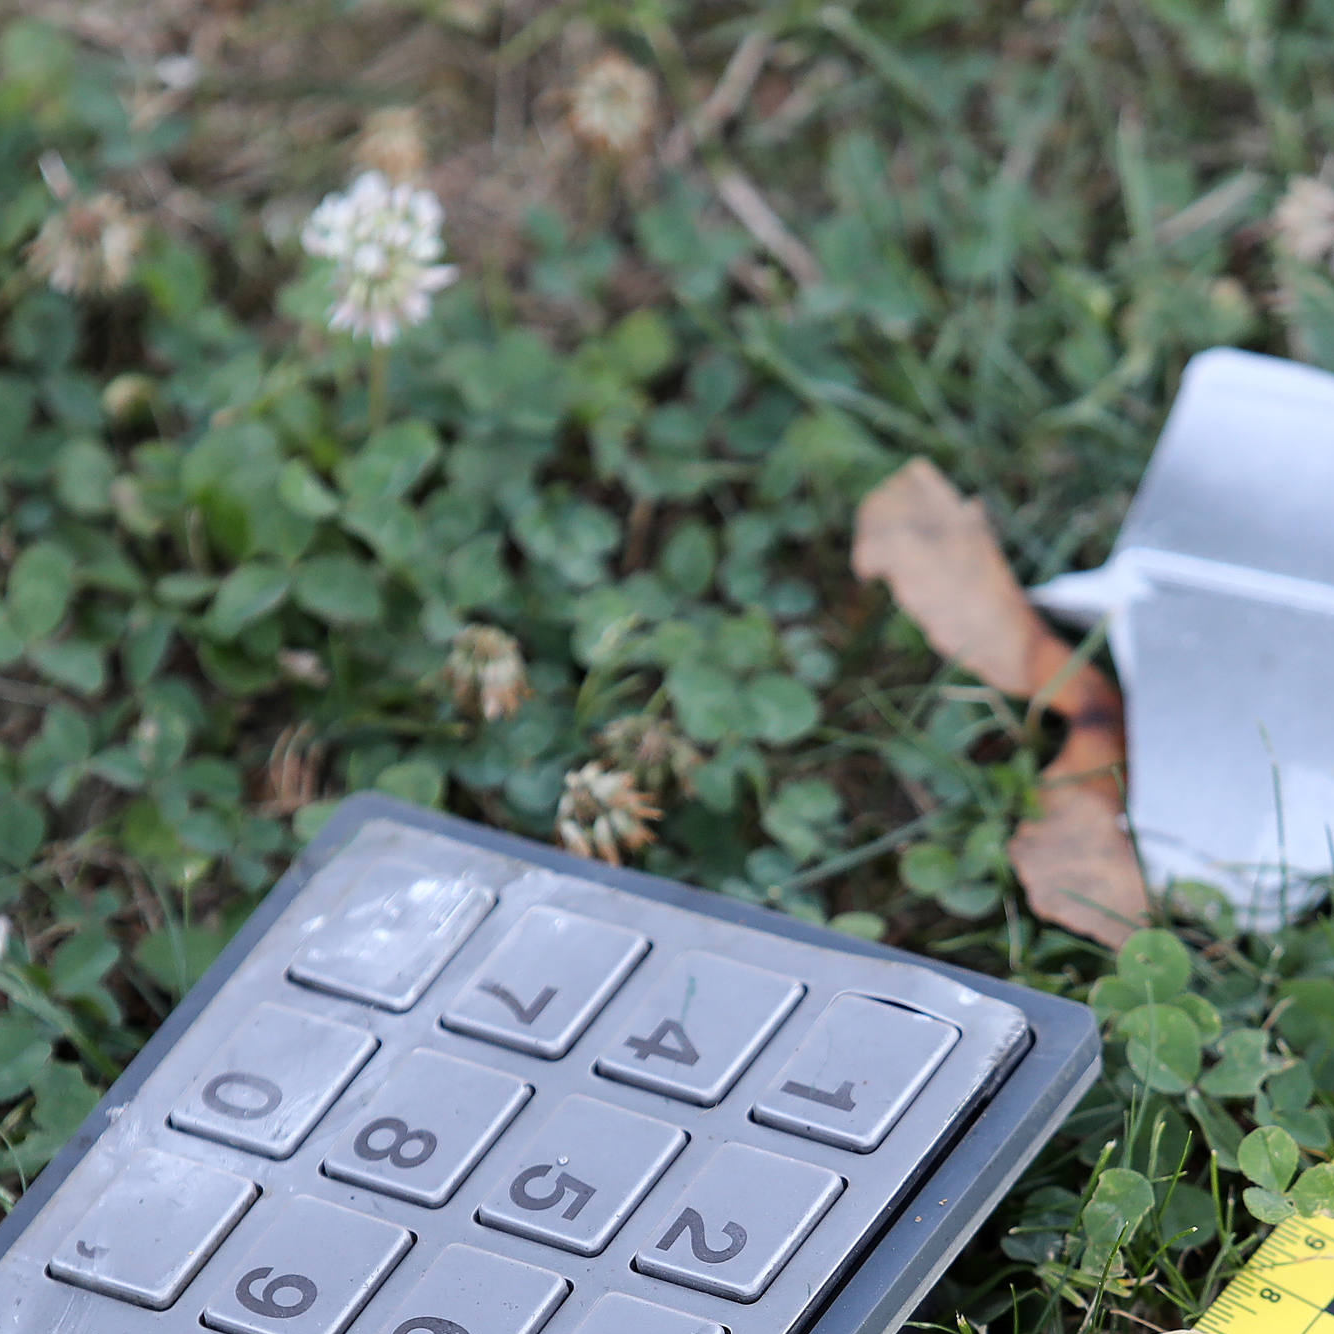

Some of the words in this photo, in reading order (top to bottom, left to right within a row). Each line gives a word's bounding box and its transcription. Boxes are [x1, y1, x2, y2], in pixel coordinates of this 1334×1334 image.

[476, 979, 559, 1025] 7
[623, 1017, 700, 1067] 4
[201, 1072, 282, 1119] 0
[780, 1079, 856, 1113] 1
[353, 1117, 437, 1169] 8
[509, 1164, 597, 1220] 5
[655, 1207, 747, 1263] 2
[1304, 1234, 1326, 1250] 9
[235, 1266, 318, 1318] 9
[1259, 1287, 1281, 1304] 8
